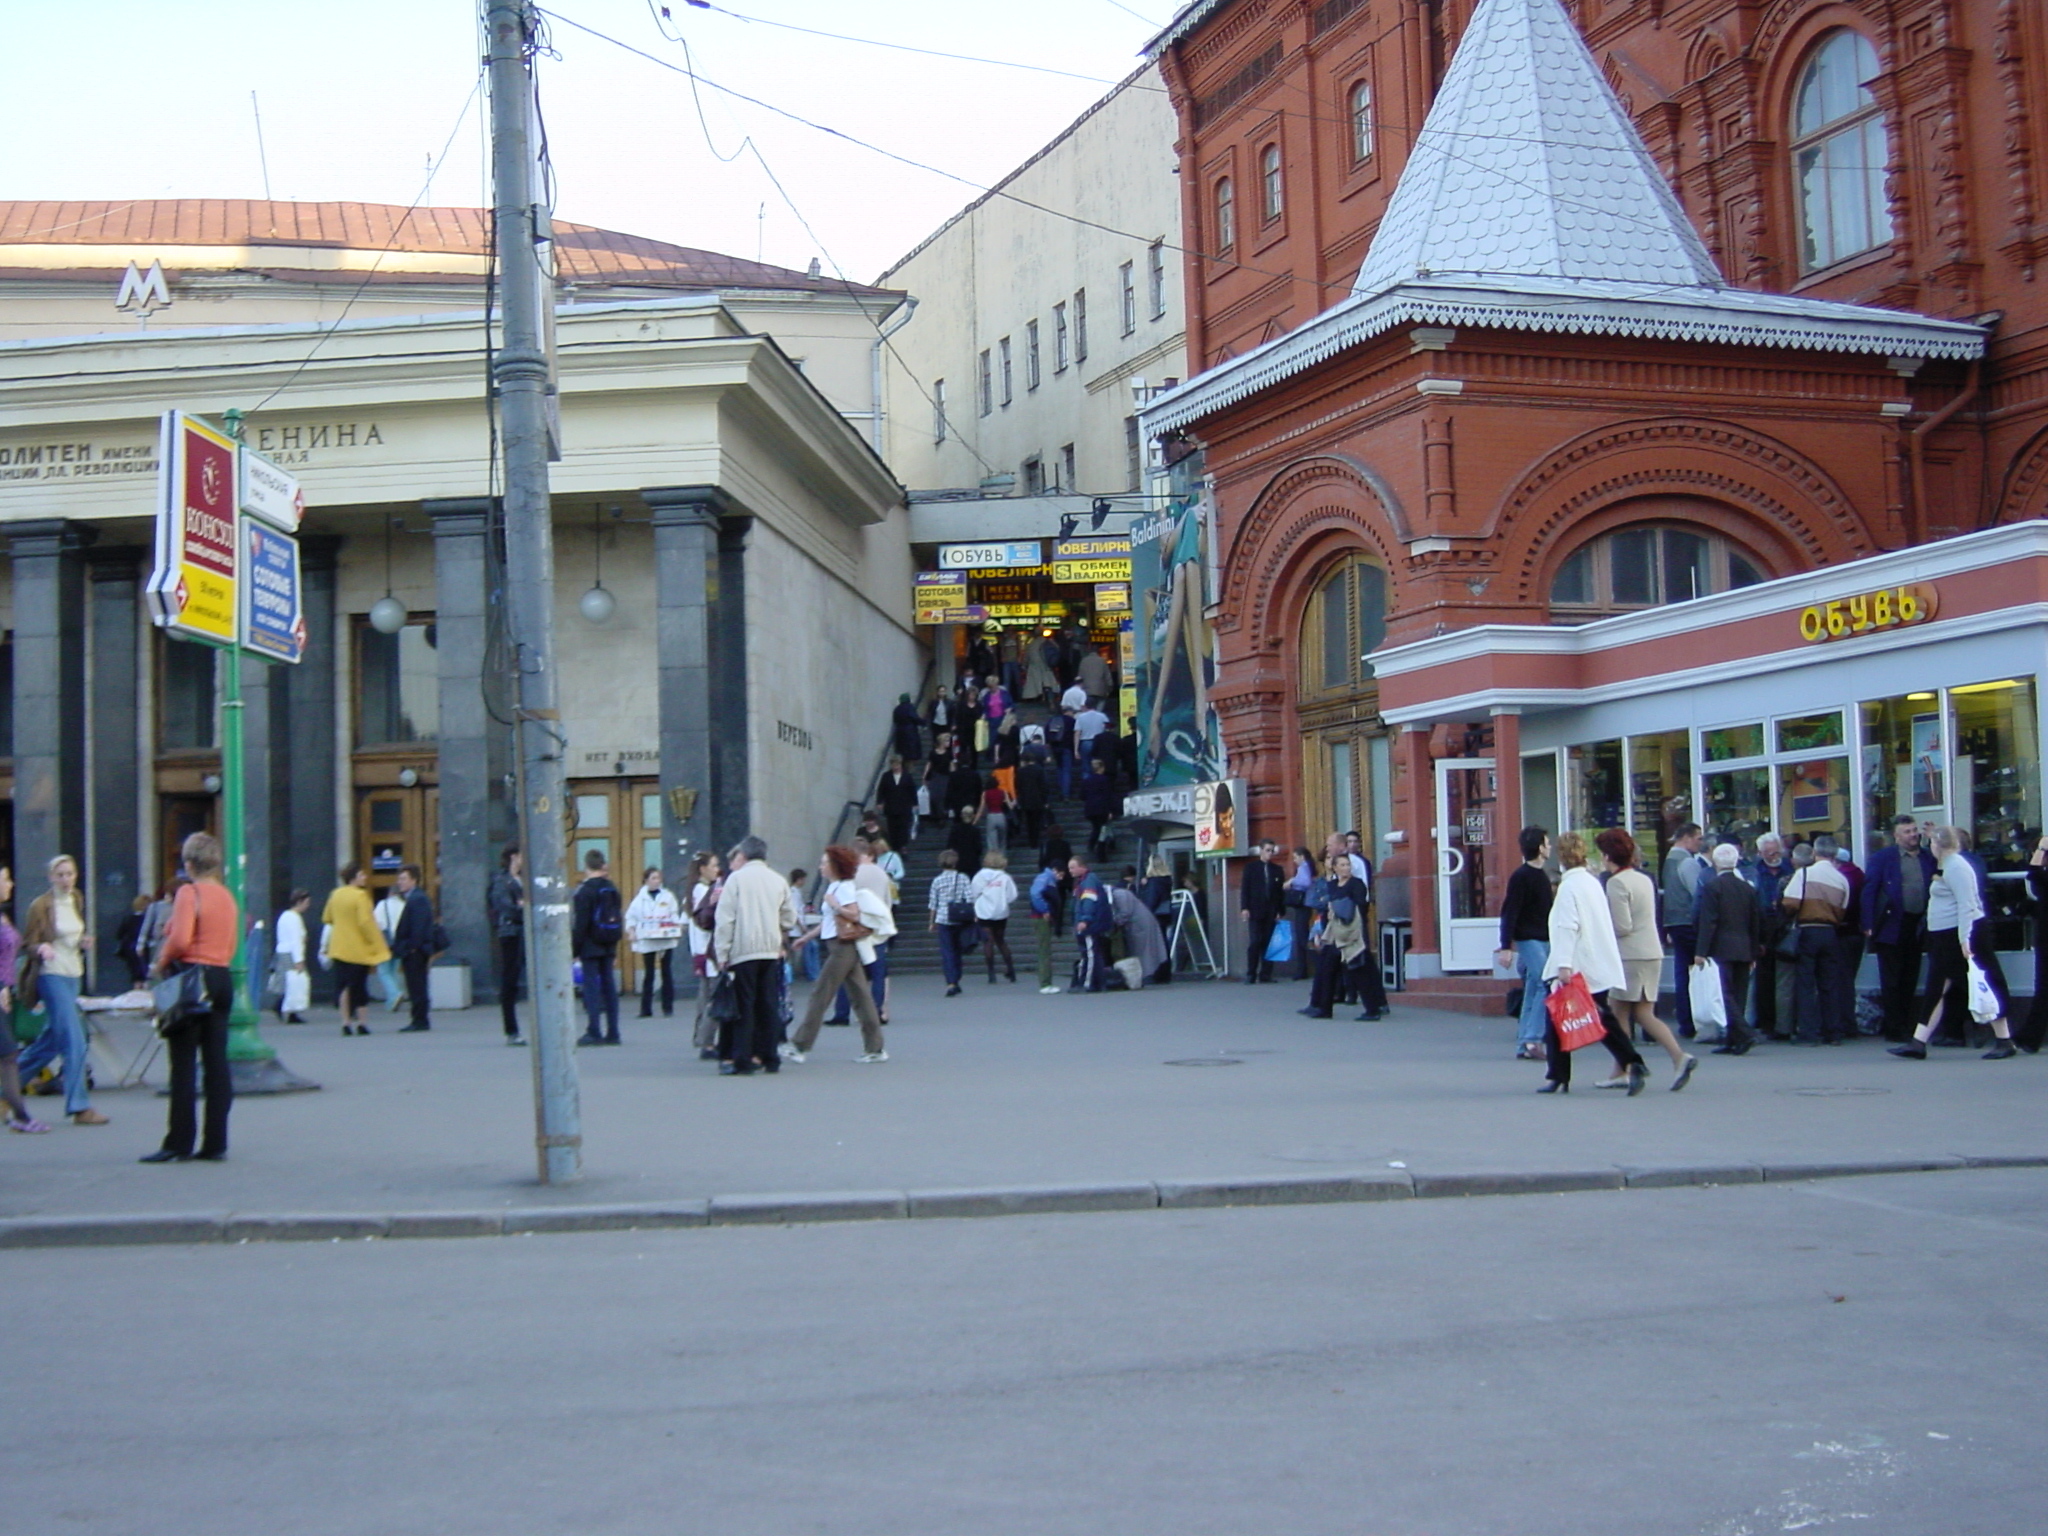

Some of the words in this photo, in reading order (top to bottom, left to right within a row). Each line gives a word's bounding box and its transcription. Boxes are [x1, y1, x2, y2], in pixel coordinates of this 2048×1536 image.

[102, 446, 151, 460] ИМЕНИ
[1131, 508, 1175, 548] Baldinini
[951, 549, 1003, 563] ОБУВЬ
[1080, 561, 1127, 571] ОБМЕН
[917, 587, 963, 597] СОТОВАЯ
[1800, 586, 1916, 641] ОБУВЬ
[1561, 1012, 1593, 1033] West
